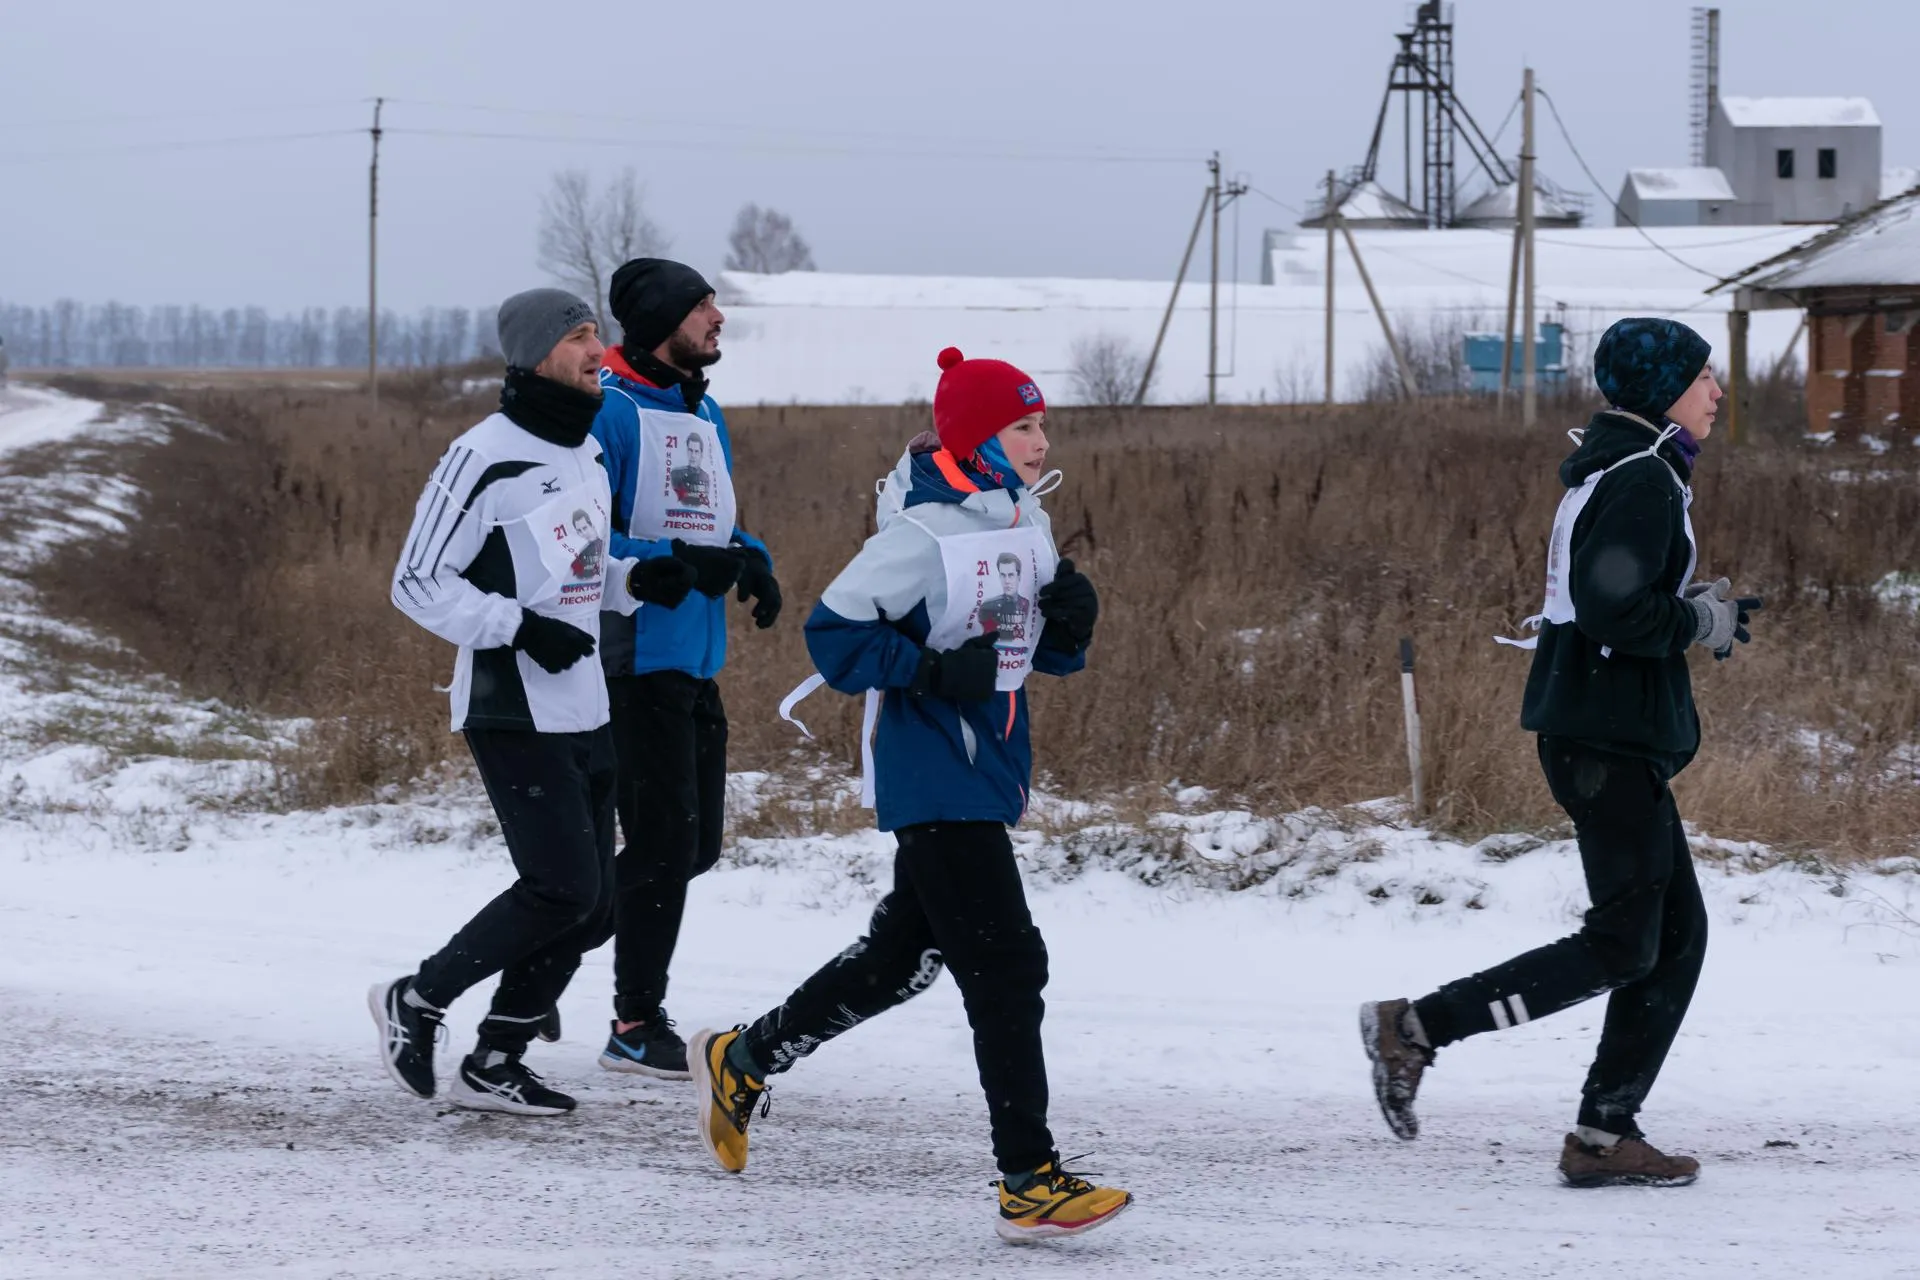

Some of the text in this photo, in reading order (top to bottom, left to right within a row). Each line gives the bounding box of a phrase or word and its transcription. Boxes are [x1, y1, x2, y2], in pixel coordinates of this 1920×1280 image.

[665, 435, 678, 448] 21
[664, 452, 672, 497] НОЯБРЯ
[665, 509, 716, 520] ВИКТОР
[553, 524, 568, 541] 21
[662, 520, 715, 531] ЛЕОНОВ
[976, 560, 989, 576] 21
[965, 581, 984, 631] НОЯБРЯ
